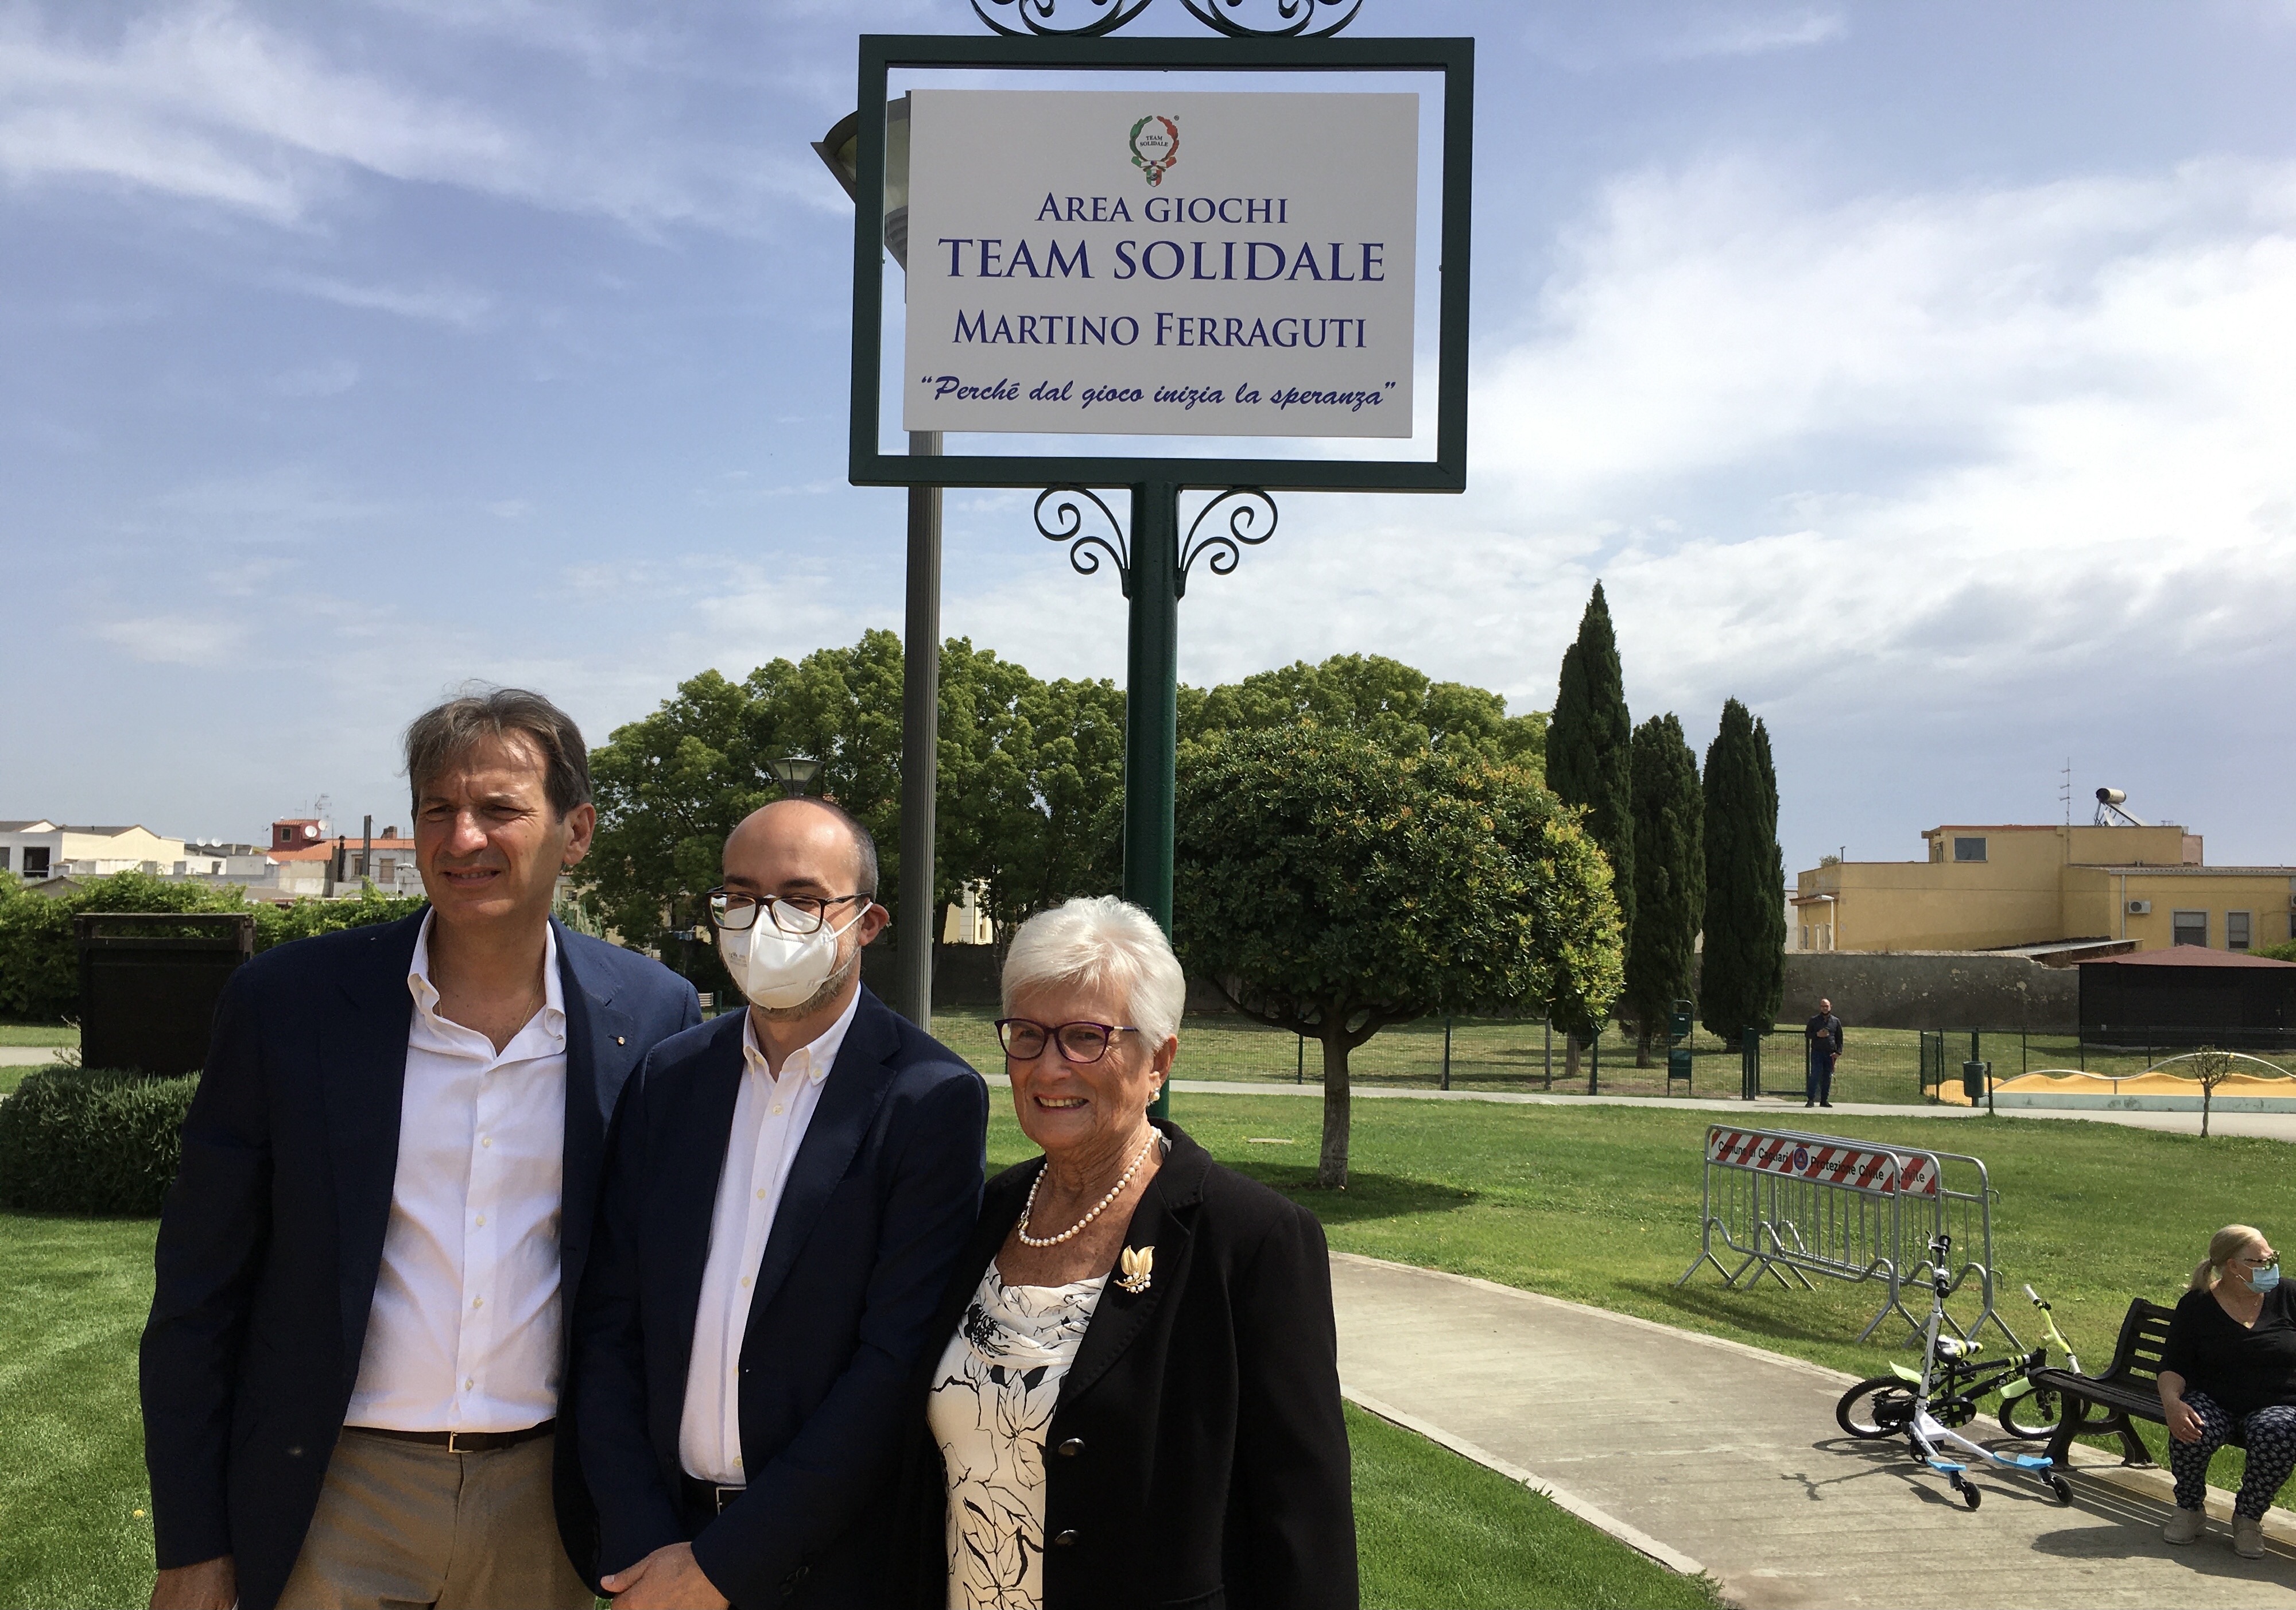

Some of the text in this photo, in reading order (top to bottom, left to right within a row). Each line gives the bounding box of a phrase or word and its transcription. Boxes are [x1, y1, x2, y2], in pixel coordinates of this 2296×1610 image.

[1034, 192, 1288, 224] AREA GIOCHI
[938, 238, 1384, 282] TEAM SOLIDALE
[952, 309, 1367, 348] MARTINO FERRAGUTI
[1029, 380, 1073, 402] dal
[1081, 385, 1145, 409] gioco
[1154, 386, 1225, 410] inizia
[1235, 382, 1262, 405] la
[1718, 1140, 1884, 1181] Comune di Cagliari Protezione Civile
